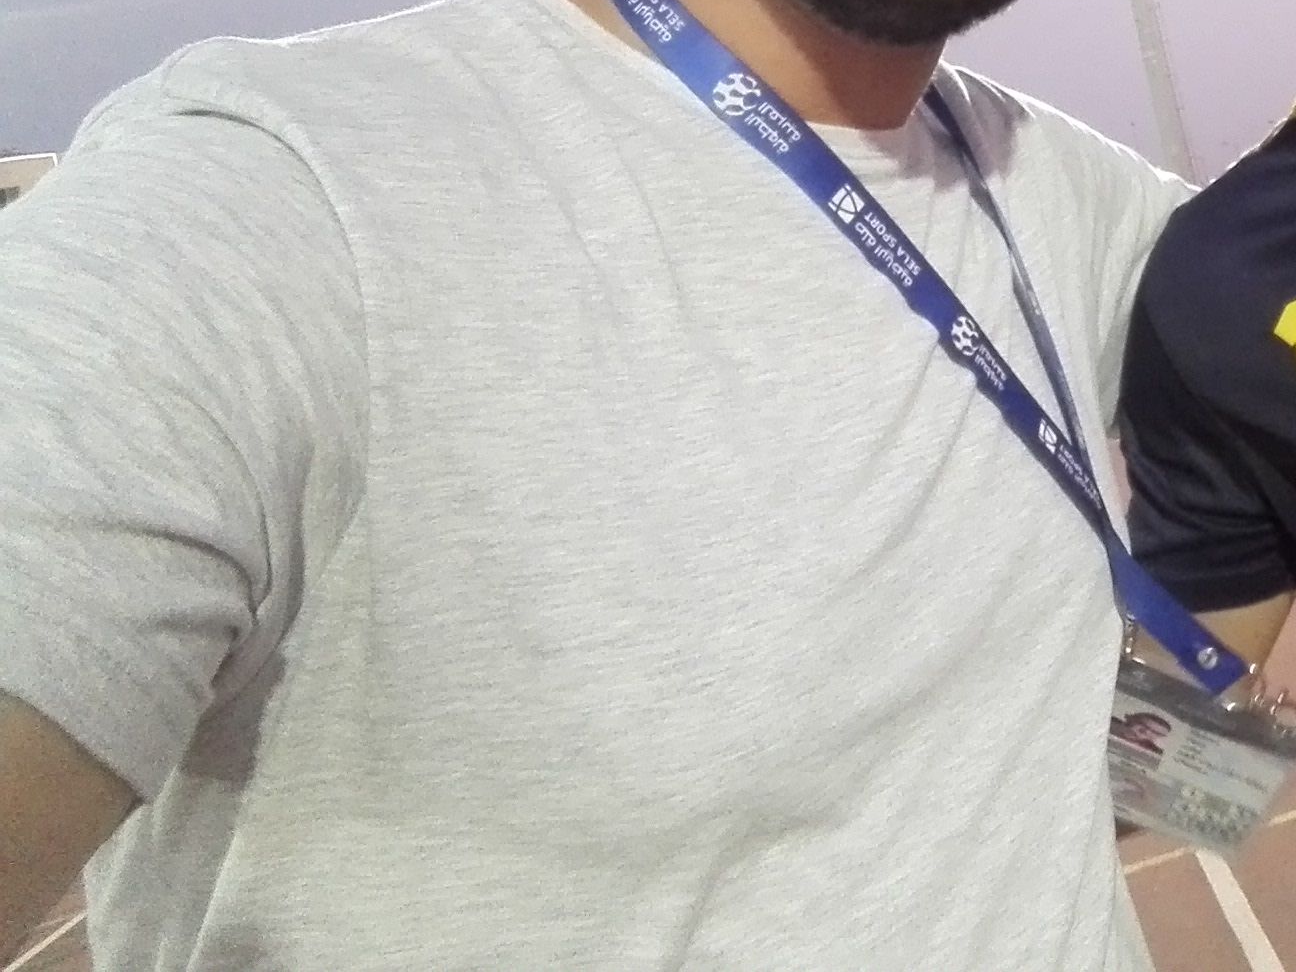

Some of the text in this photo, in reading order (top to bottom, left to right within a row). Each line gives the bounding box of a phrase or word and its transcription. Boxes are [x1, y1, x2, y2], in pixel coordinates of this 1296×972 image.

[659, 4, 685, 32] SELA
[864, 212, 921, 276] SELA SPORT
